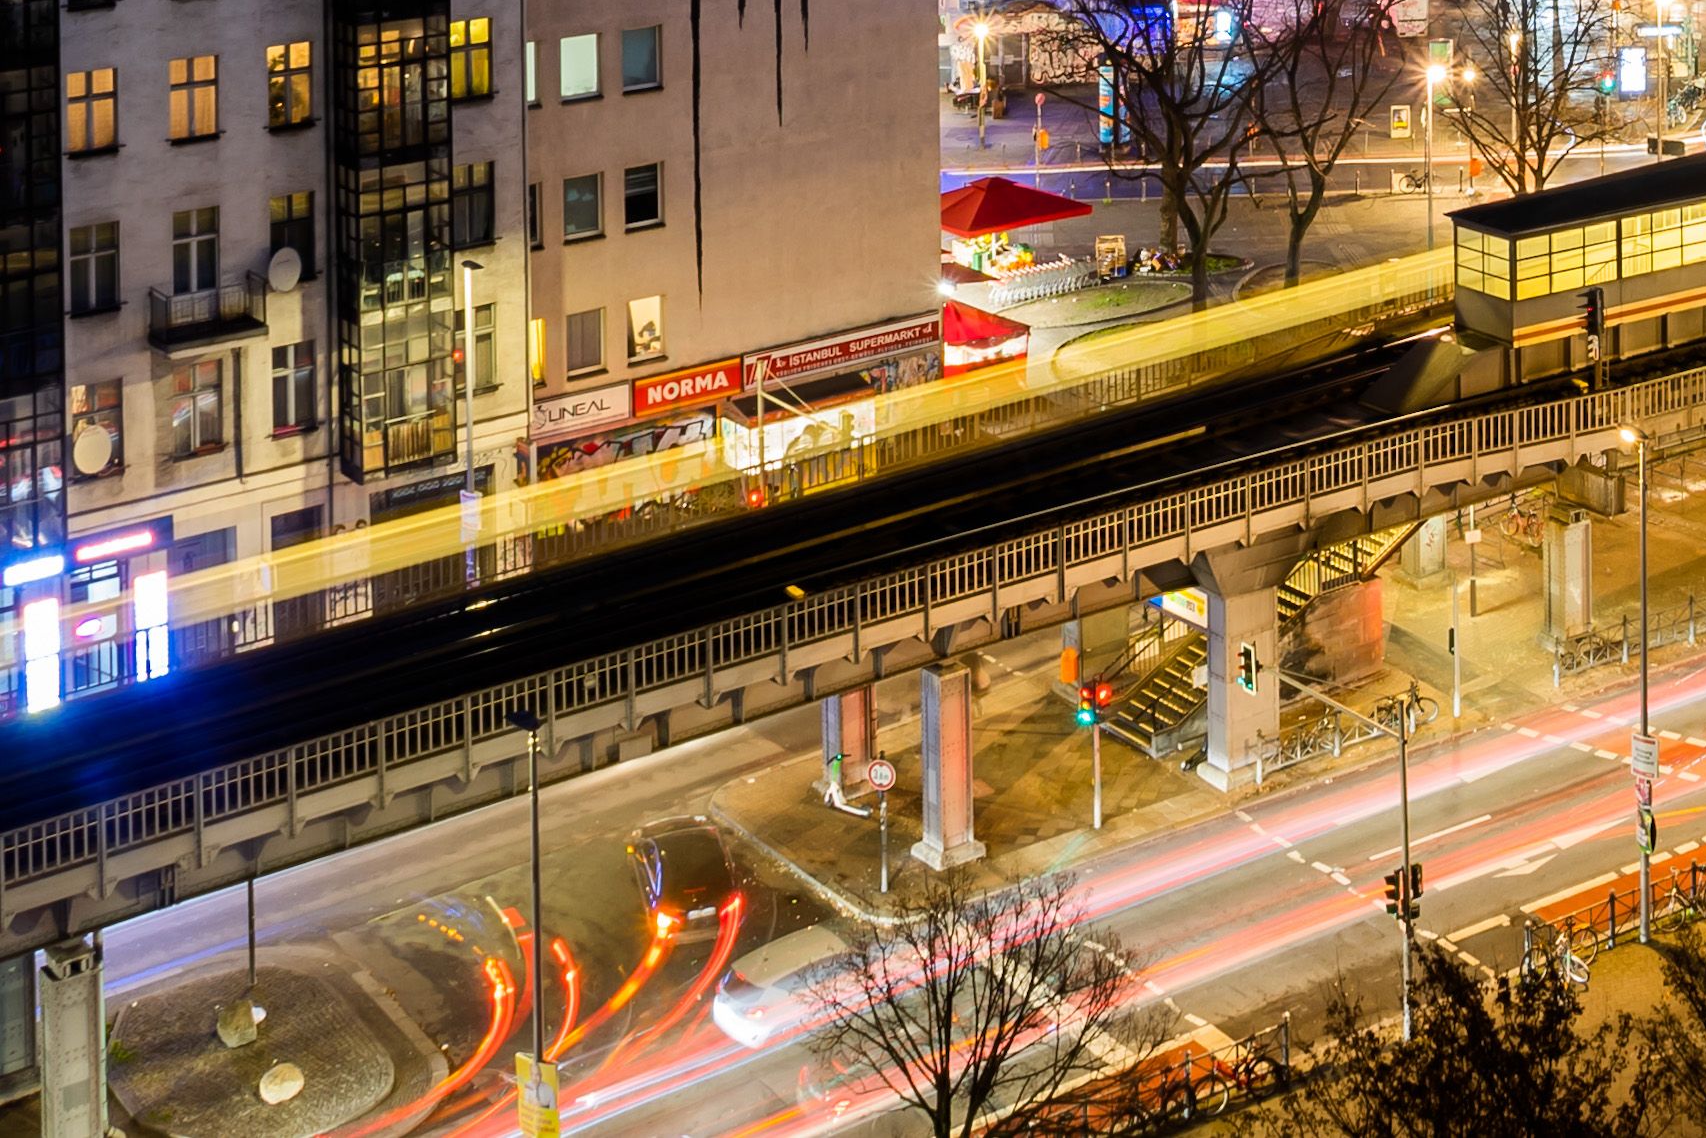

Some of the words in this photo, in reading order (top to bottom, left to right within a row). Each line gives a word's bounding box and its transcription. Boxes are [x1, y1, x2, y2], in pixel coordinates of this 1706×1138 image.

[849, 327, 921, 353] SUPERMARKT
[647, 371, 729, 406] NORMA
[548, 398, 611, 422] LINEAL
